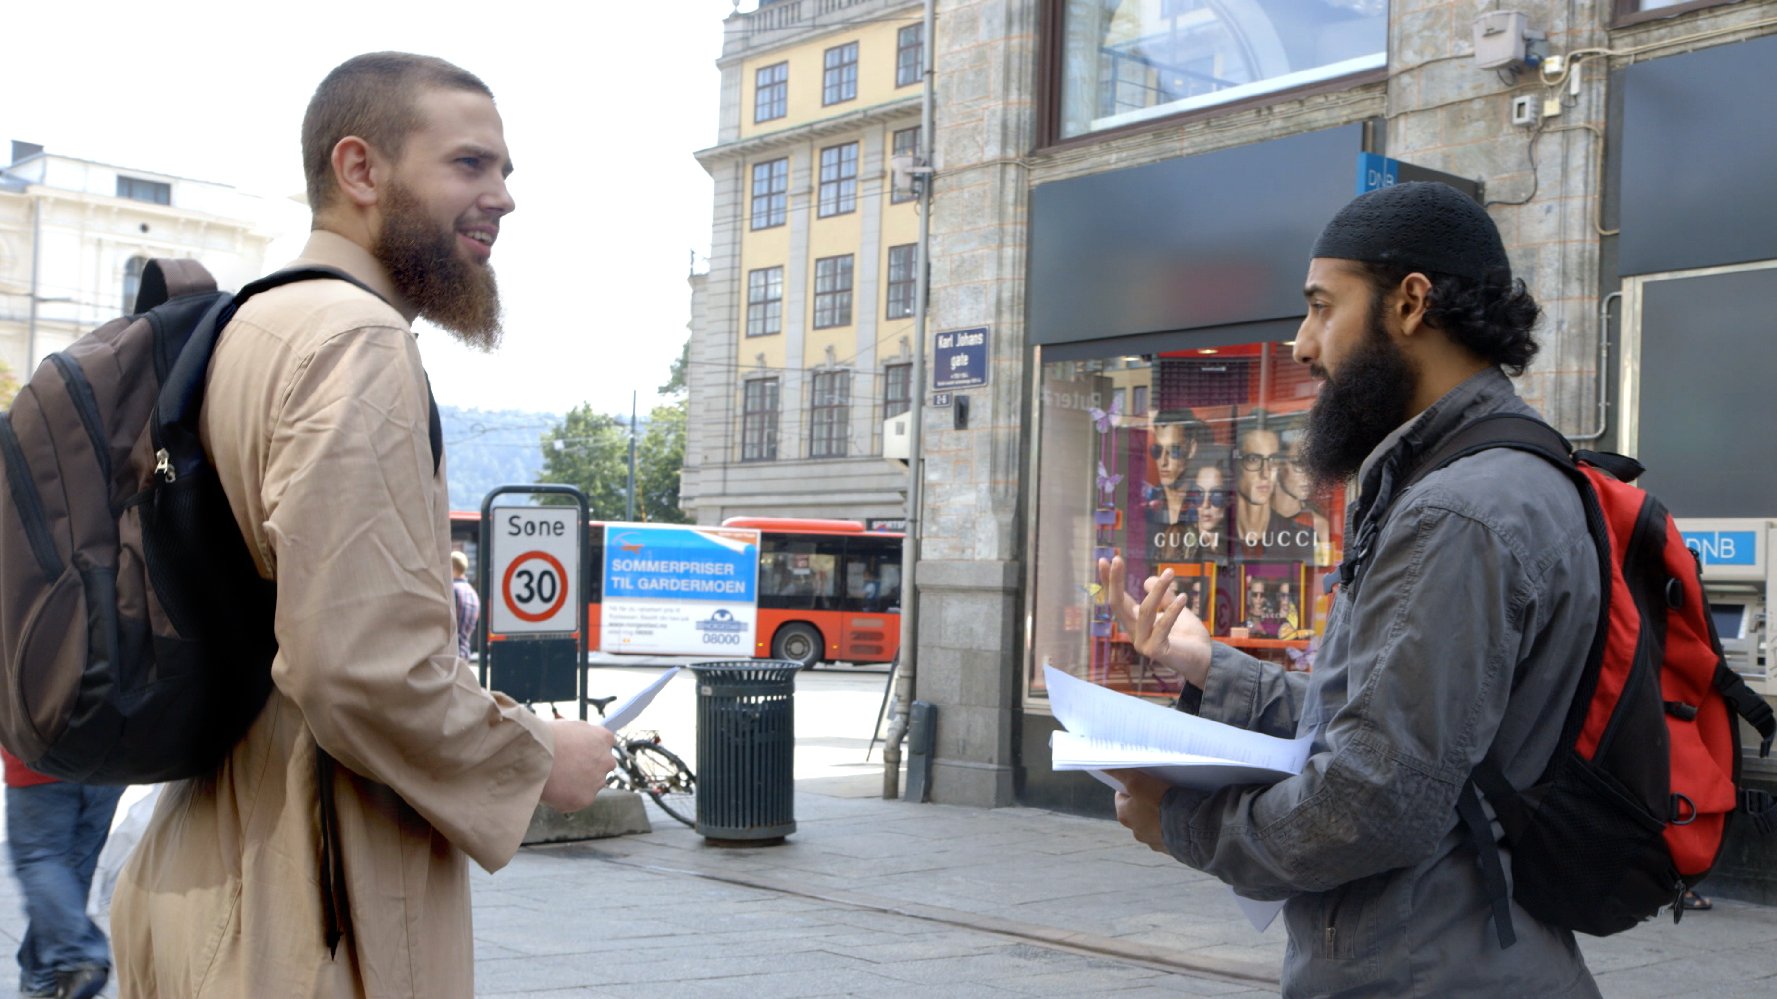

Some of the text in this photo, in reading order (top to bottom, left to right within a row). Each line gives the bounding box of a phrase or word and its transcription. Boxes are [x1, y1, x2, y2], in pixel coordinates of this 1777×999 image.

[938, 332, 984, 349] Karl Johans
[950, 353, 969, 370] gate
[508, 514, 565, 536] Sone
[1154, 531, 1219, 548] GUCCI
[1245, 530, 1318, 547] GUCCI
[1685, 534, 1736, 562] DNB
[611, 559, 735, 575] SOMMERPRISER
[515, 569, 556, 604] 30
[611, 576, 746, 593] TIL GARDERMOEN
[702, 633, 740, 645] 08000
